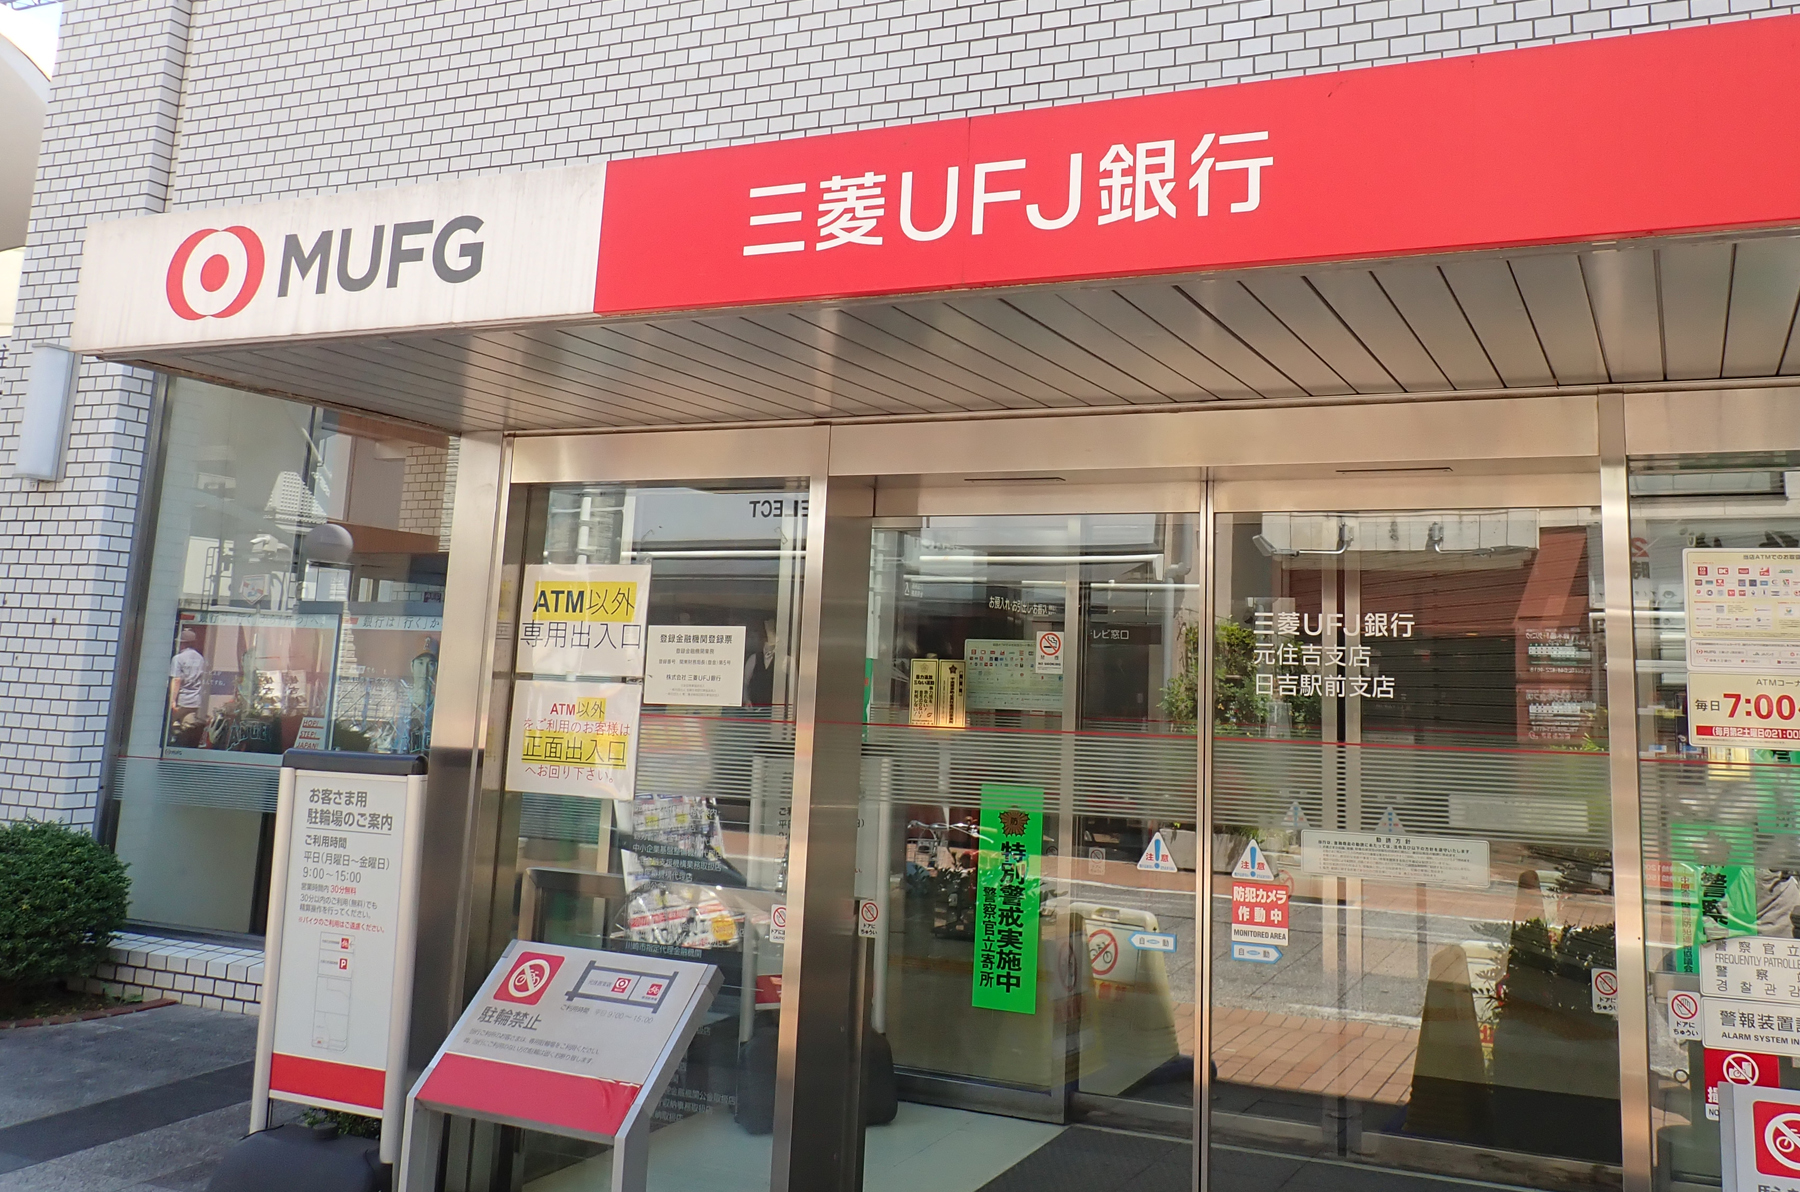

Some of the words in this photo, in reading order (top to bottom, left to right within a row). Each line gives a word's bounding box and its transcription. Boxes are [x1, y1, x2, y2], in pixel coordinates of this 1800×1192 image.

[743, 131, 1274, 256] 三菱UFJ銀行
[277, 215, 484, 297] MUFG
[533, 588, 635, 616] ATM以外
[520, 619, 641, 650] 専用出入口
[1090, 629, 1129, 640] レビ窓口
[1253, 612, 1415, 638] 三菱UFJ銀行
[1253, 643, 1371, 668] 元住吉支店
[1255, 673, 1395, 699] 日吉駅前支店
[550, 701, 604, 718] ATM以外
[1695, 699, 1720, 711] 毎日
[1723, 693, 1800, 720] 7:00
[524, 718, 630, 736] をご利用のお客様は
[1712, 727, 1800, 738] (毎月第2土曜日の21:00
[523, 736, 626, 764] 正面出入口
[525, 765, 614, 783] へお回り下さい。
[309, 788, 367, 808] お客さま用
[306, 808, 393, 831] 駐輪場のご案内
[304, 834, 347, 849] ご利用時間
[1233, 886, 1287, 904] 防犯カメラ
[996, 841, 1027, 992] 特別警戒実施中
[1238, 906, 1282, 924] 作動中
[979, 887, 997, 989] 警察官立寄所
[1233, 928, 1269, 939] MONITORED
[1270, 931, 1286, 940] AREA
[1715, 953, 1761, 966] FREQUENTLY
[477, 1006, 542, 1031] 駐輪禁止
[1720, 1010, 1800, 1033] 警報装置
[1673, 1028, 1698, 1036] ちゅうい
[1722, 1032, 1751, 1041] ALARM
[1754, 1035, 1788, 1044] SYSTEM
